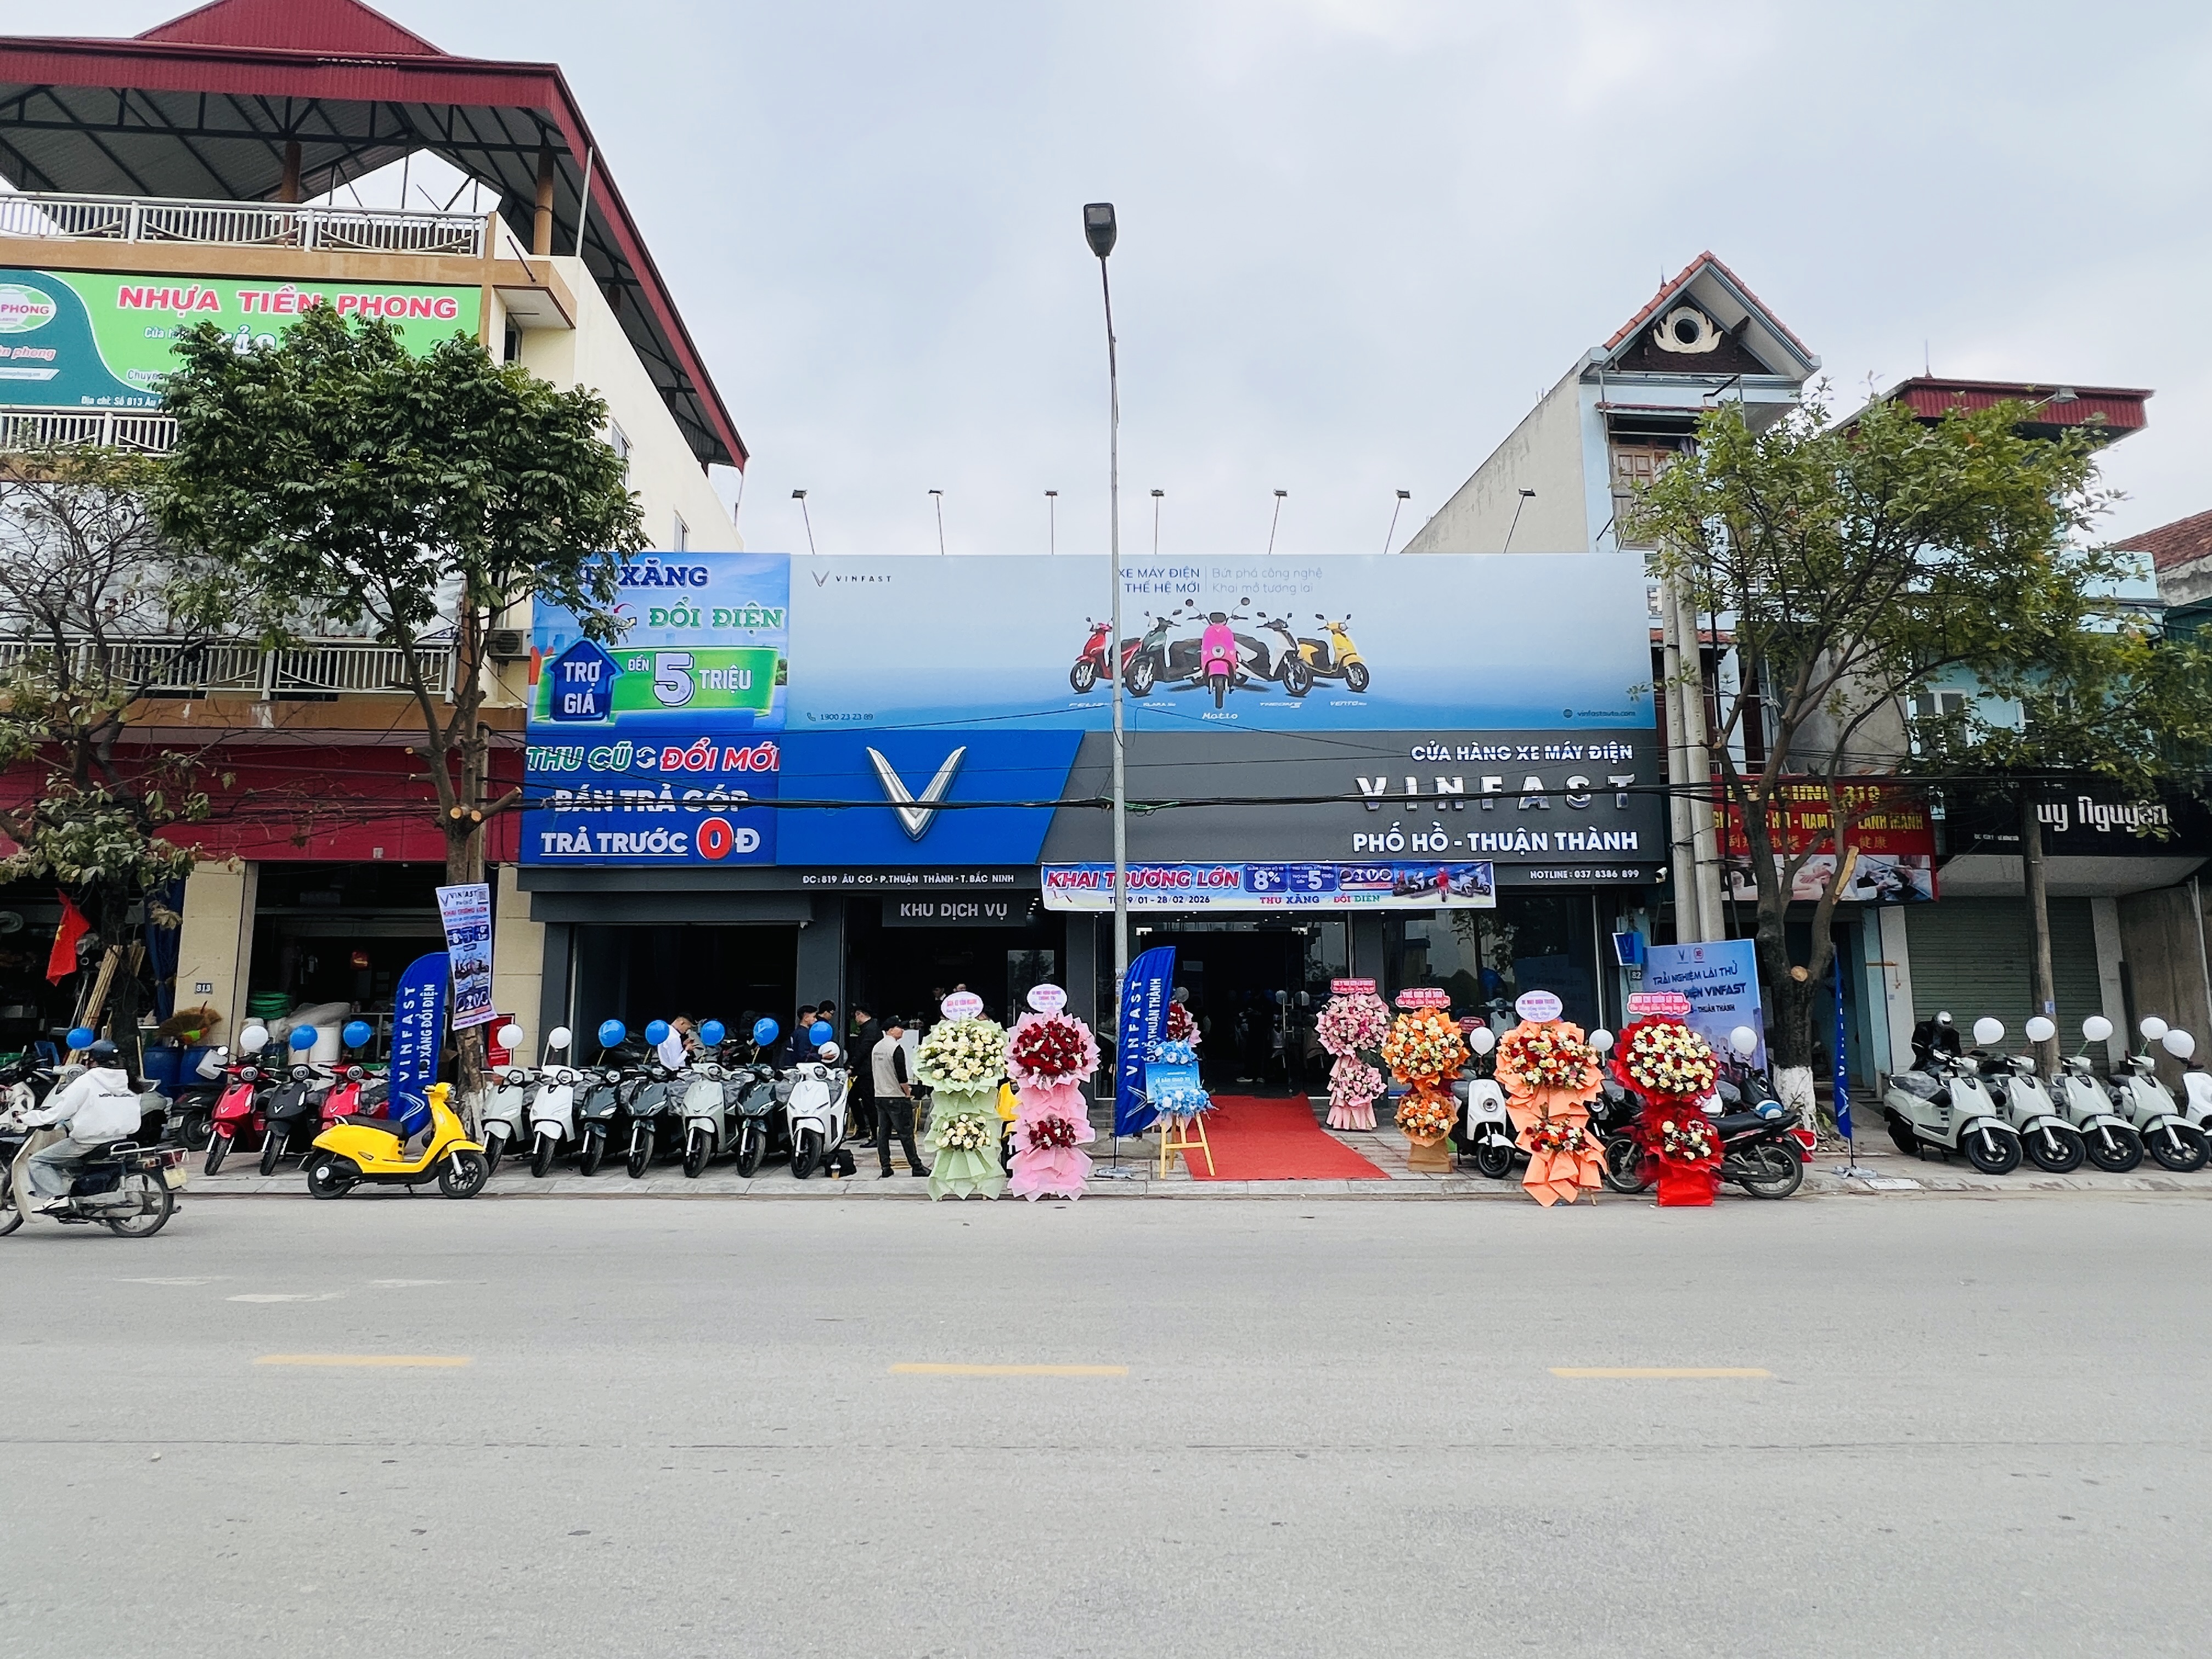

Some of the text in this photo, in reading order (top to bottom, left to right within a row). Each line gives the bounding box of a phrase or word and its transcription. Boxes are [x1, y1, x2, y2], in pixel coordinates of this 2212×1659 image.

[1, 304, 49, 314] PHONG
[117, 283, 458, 319] NHỰA TIỀN PHONG
[618, 558, 709, 587] XĂNG
[1118, 566, 1200, 580] XE MÁY ĐIỆN
[1212, 565, 1323, 581] Bứt phá công nghệ
[1124, 580, 1200, 594] THẾ HỆ MỚI
[1212, 582, 1313, 596] Khai mở tương lai
[649, 596, 783, 635] ĐỔI ĐIỆN
[564, 660, 602, 687] TRỢ
[628, 652, 752, 707] ĐẾN 5 TRIỆU
[564, 691, 595, 714] GIÁ
[526, 746, 585, 771] THU
[587, 741, 633, 771] CŨ
[660, 737, 718, 772] ĐỔI
[1410, 740, 1633, 764] CỬA HÀNG XE MÁY ĐIỆN
[1355, 774, 1635, 811] VINFAST
[541, 826, 592, 853] TRẢ
[596, 831, 688, 853] TRƯỚC
[1352, 822, 1404, 852] PHỐ
[1412, 822, 1449, 852] HỒ
[1467, 828, 1548, 855] THUẬN
[1554, 827, 1638, 851] THÀNH
[842, 873, 855, 884] ÂU
[992, 874, 1014, 883] NINH
[1046, 866, 1242, 890] KHAI TƯƠNG LỚN
[1254, 870, 1280, 890] 8%
[1308, 870, 1322, 890] 5
[1574, 870, 1591, 878] 037
[1595, 870, 1618, 878] 8386
[1622, 870, 1639, 878] 899
[1286, 894, 1319, 904] XĂNG
[900, 903, 1007, 921] KHU DỊCH VỤ
[420, 984, 438, 1007] ĐIỆN
[1146, 978, 1161, 1008] THÀNH
[415, 1008, 433, 1028] ĐỔI
[1126, 980, 1142, 1076] VINFAST
[1144, 1009, 1161, 1039] THUẬN
[399, 987, 415, 1082] VINFAST
[416, 1029, 433, 1057] XĂNG
